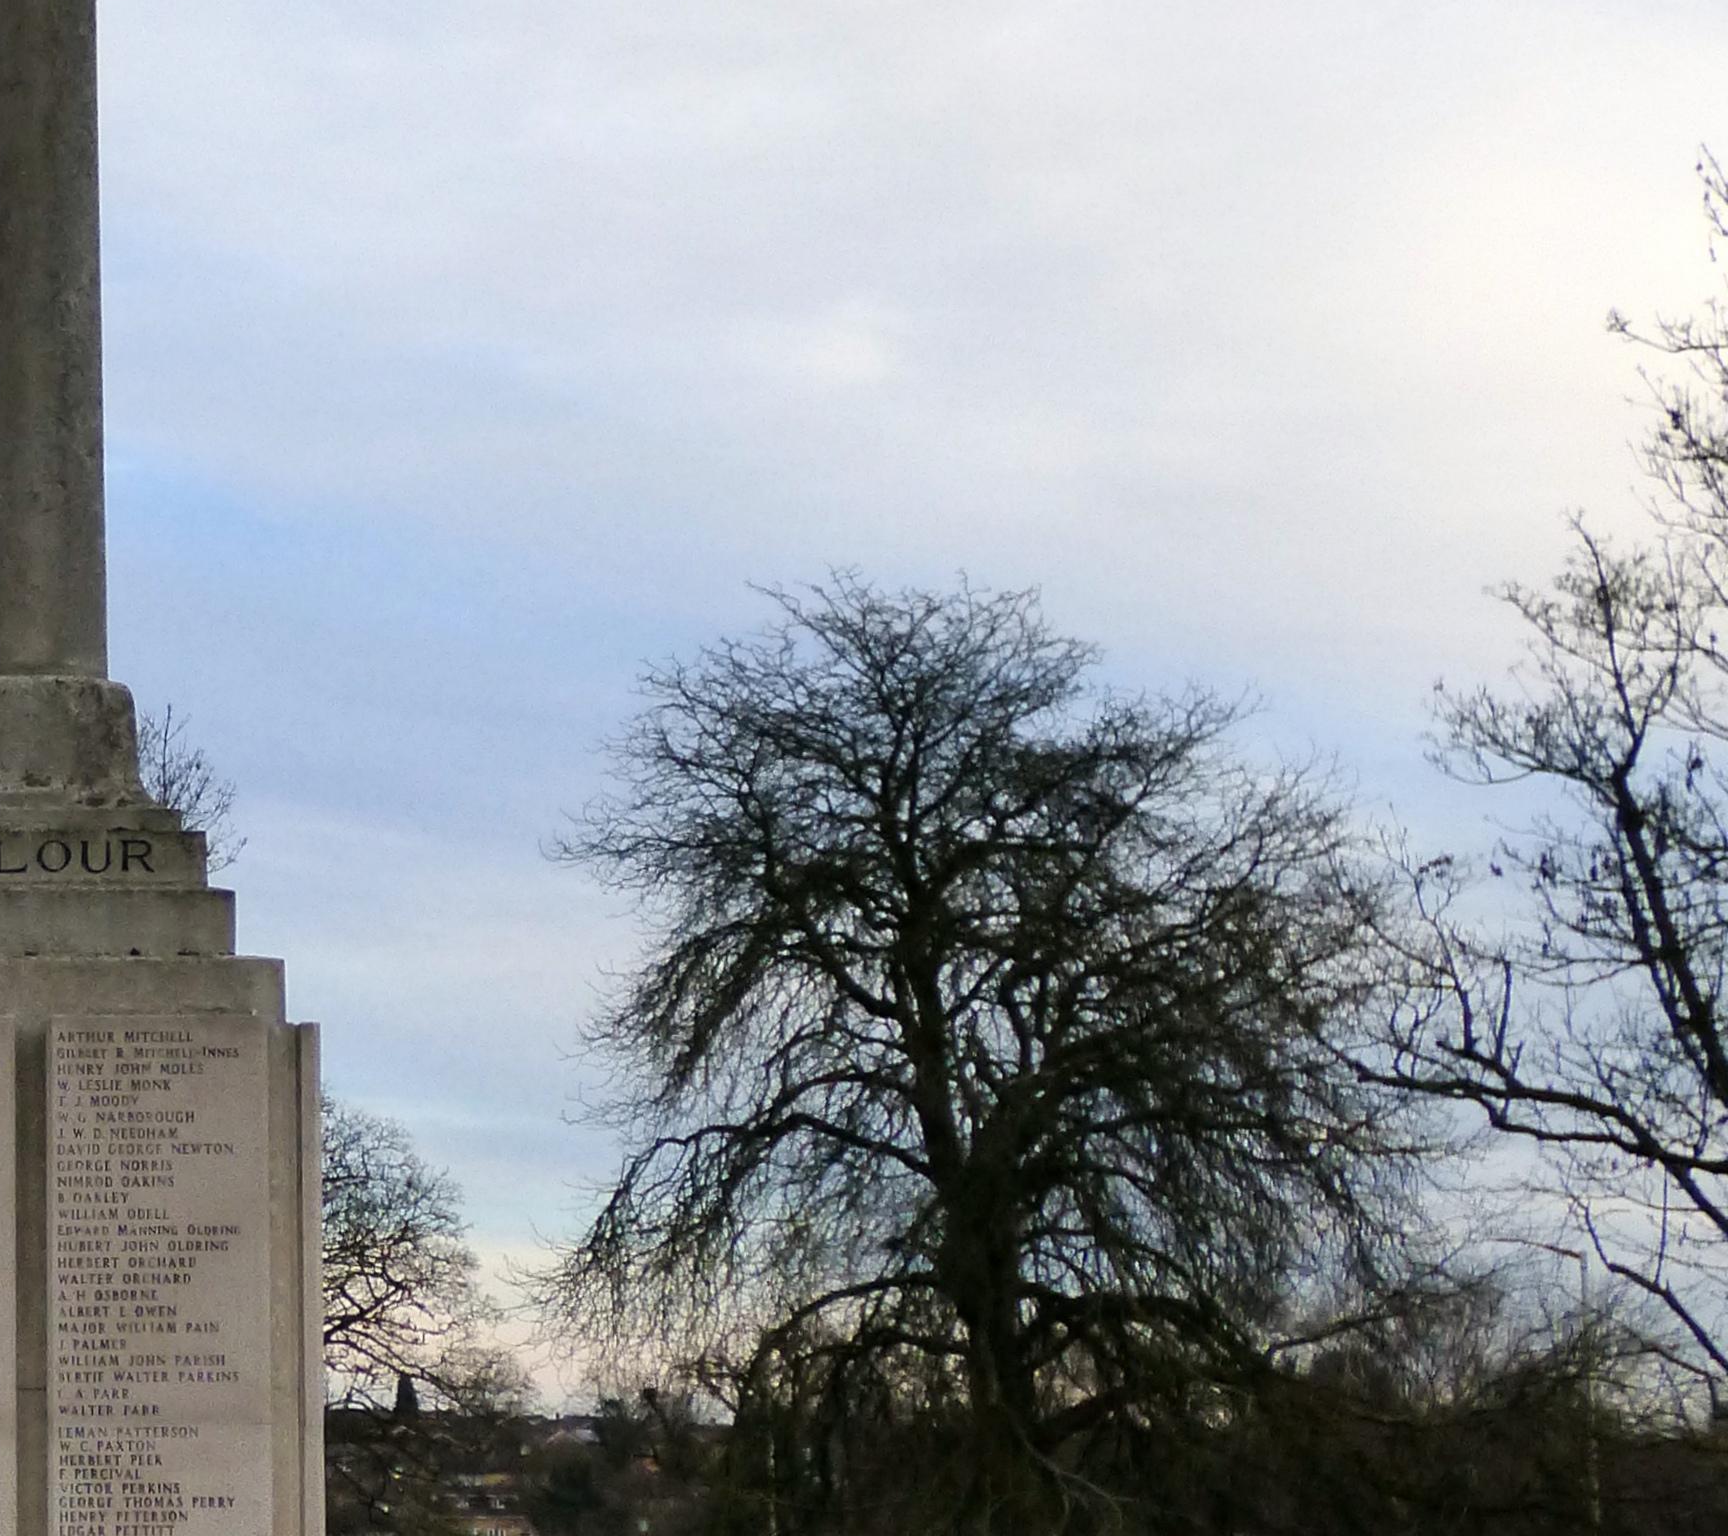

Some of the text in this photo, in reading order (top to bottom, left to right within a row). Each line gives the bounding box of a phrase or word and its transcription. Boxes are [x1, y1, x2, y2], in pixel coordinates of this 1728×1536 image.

[58, 1032, 193, 1042] ARTHUR MITCHELL
[57, 1064, 150, 1075] HENRY JOHN
[78, 1080, 171, 1091] LESLIE MONK
[90, 1096, 138, 1107] MOODY
[110, 1128, 178, 1139] NEEDHAM
[57, 1144, 234, 1155] DAVID GEORGE NEWTON
[57, 1160, 172, 1172] GEORGE NORRIS
[57, 1176, 112, 1187] NIMROD
[73, 1193, 129, 1203] OAKLEY
[59, 1209, 169, 1219] WILLIAM ODELL
[57, 1225, 241, 1236] EDWARD MANNING OLDRING
[58, 1241, 228, 1252] HUBERT JOHN OLDRING
[57, 1257, 196, 1268] HERBERT ORCHARD
[58, 1274, 191, 1284] WALTER ORCHARD
[94, 1290, 159, 1301] OSBORNE
[59, 1306, 176, 1317] ALBERT OWEN
[58, 1322, 219, 1334] MAJOR WILLIAM PAIN
[73, 1339, 126, 1350] PALMER
[59, 1355, 225, 1366] WILLIAM JOHN PARISH
[114, 1371, 239, 1383] WALTER PARKINS
[59, 1405, 113, 1416] WALTER
[117, 1427, 198, 1438] PATTERSON
[97, 1440, 155, 1452] PAXTON
[59, 1455, 120, 1466] HERBERT
[75, 1469, 141, 1480] PERCIVAL
[61, 1483, 180, 1494] VICTOR PERKINS
[59, 1497, 235, 1508] GEORGE THOMAS PERRY
[59, 1511, 188, 1522] HENRY PETERSON
[59, 1525, 174, 1536] EDGAR PETTITT
